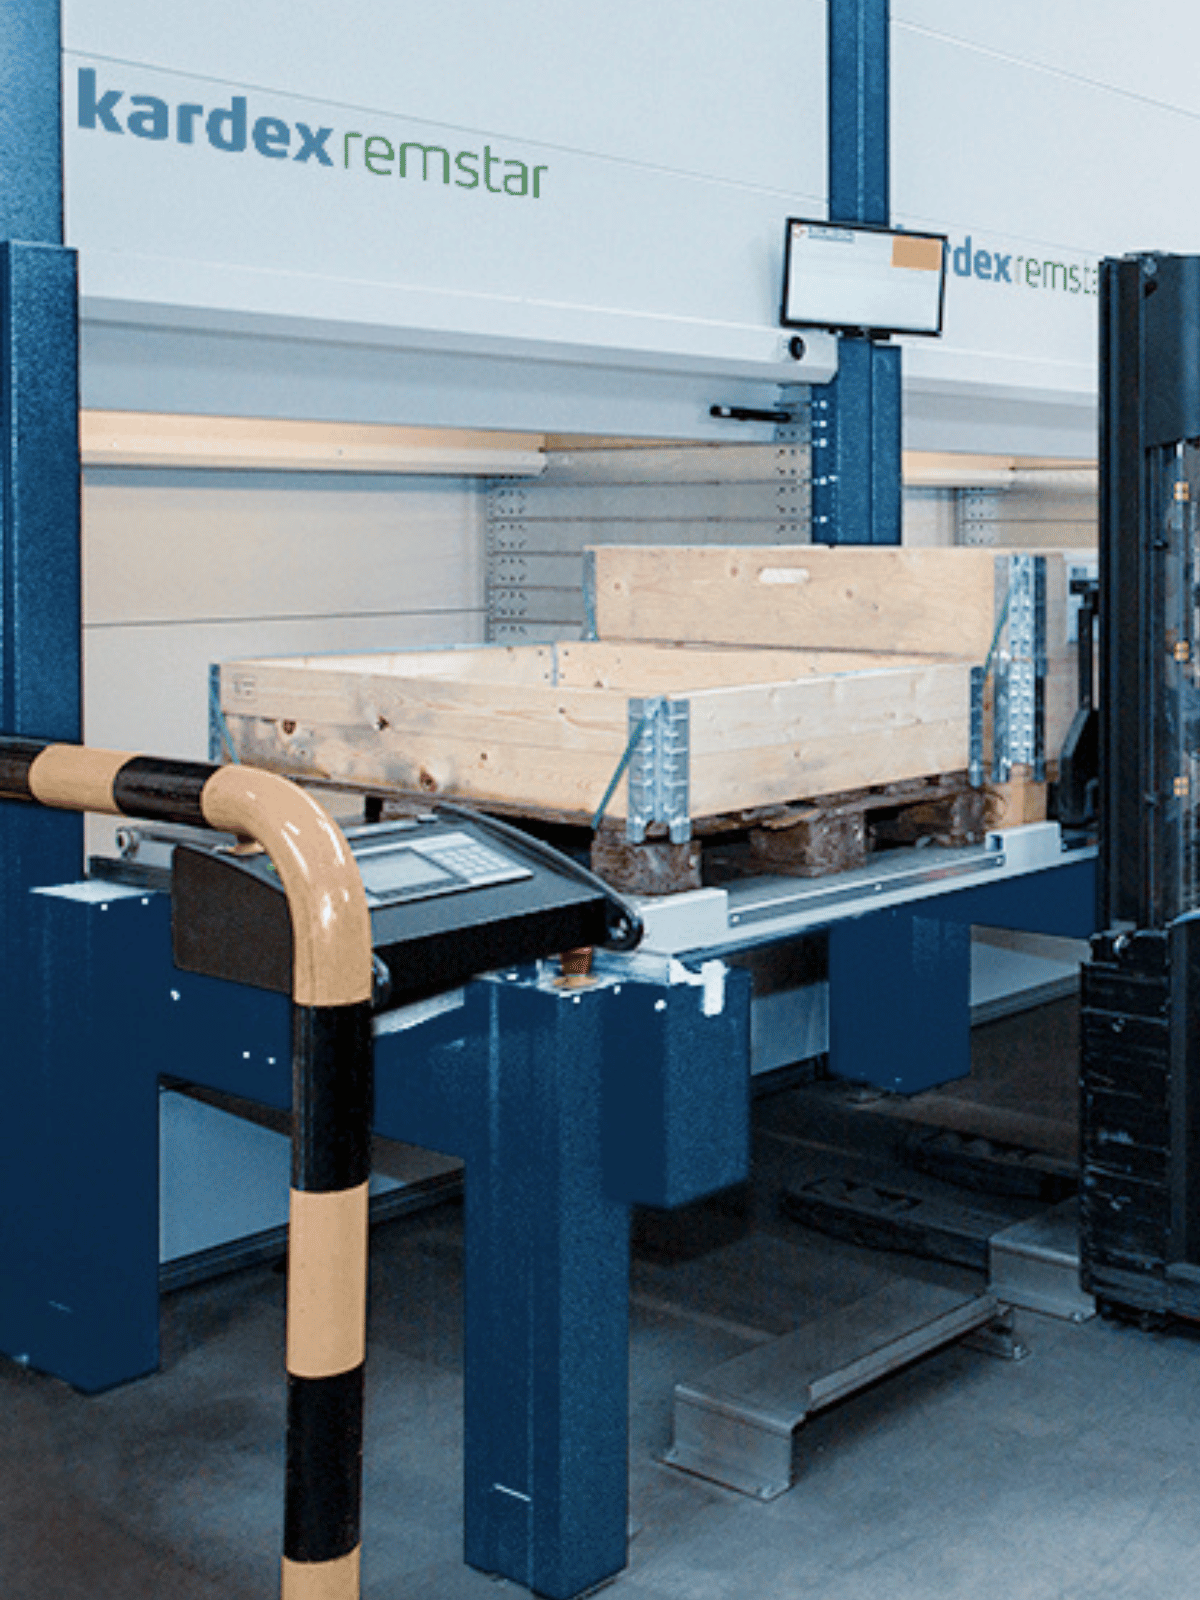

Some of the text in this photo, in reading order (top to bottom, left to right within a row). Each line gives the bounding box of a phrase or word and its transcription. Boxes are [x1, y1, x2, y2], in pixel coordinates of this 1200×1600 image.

[77, 66, 549, 199] kardex remstar
[1014, 255, 1099, 295] remsta
